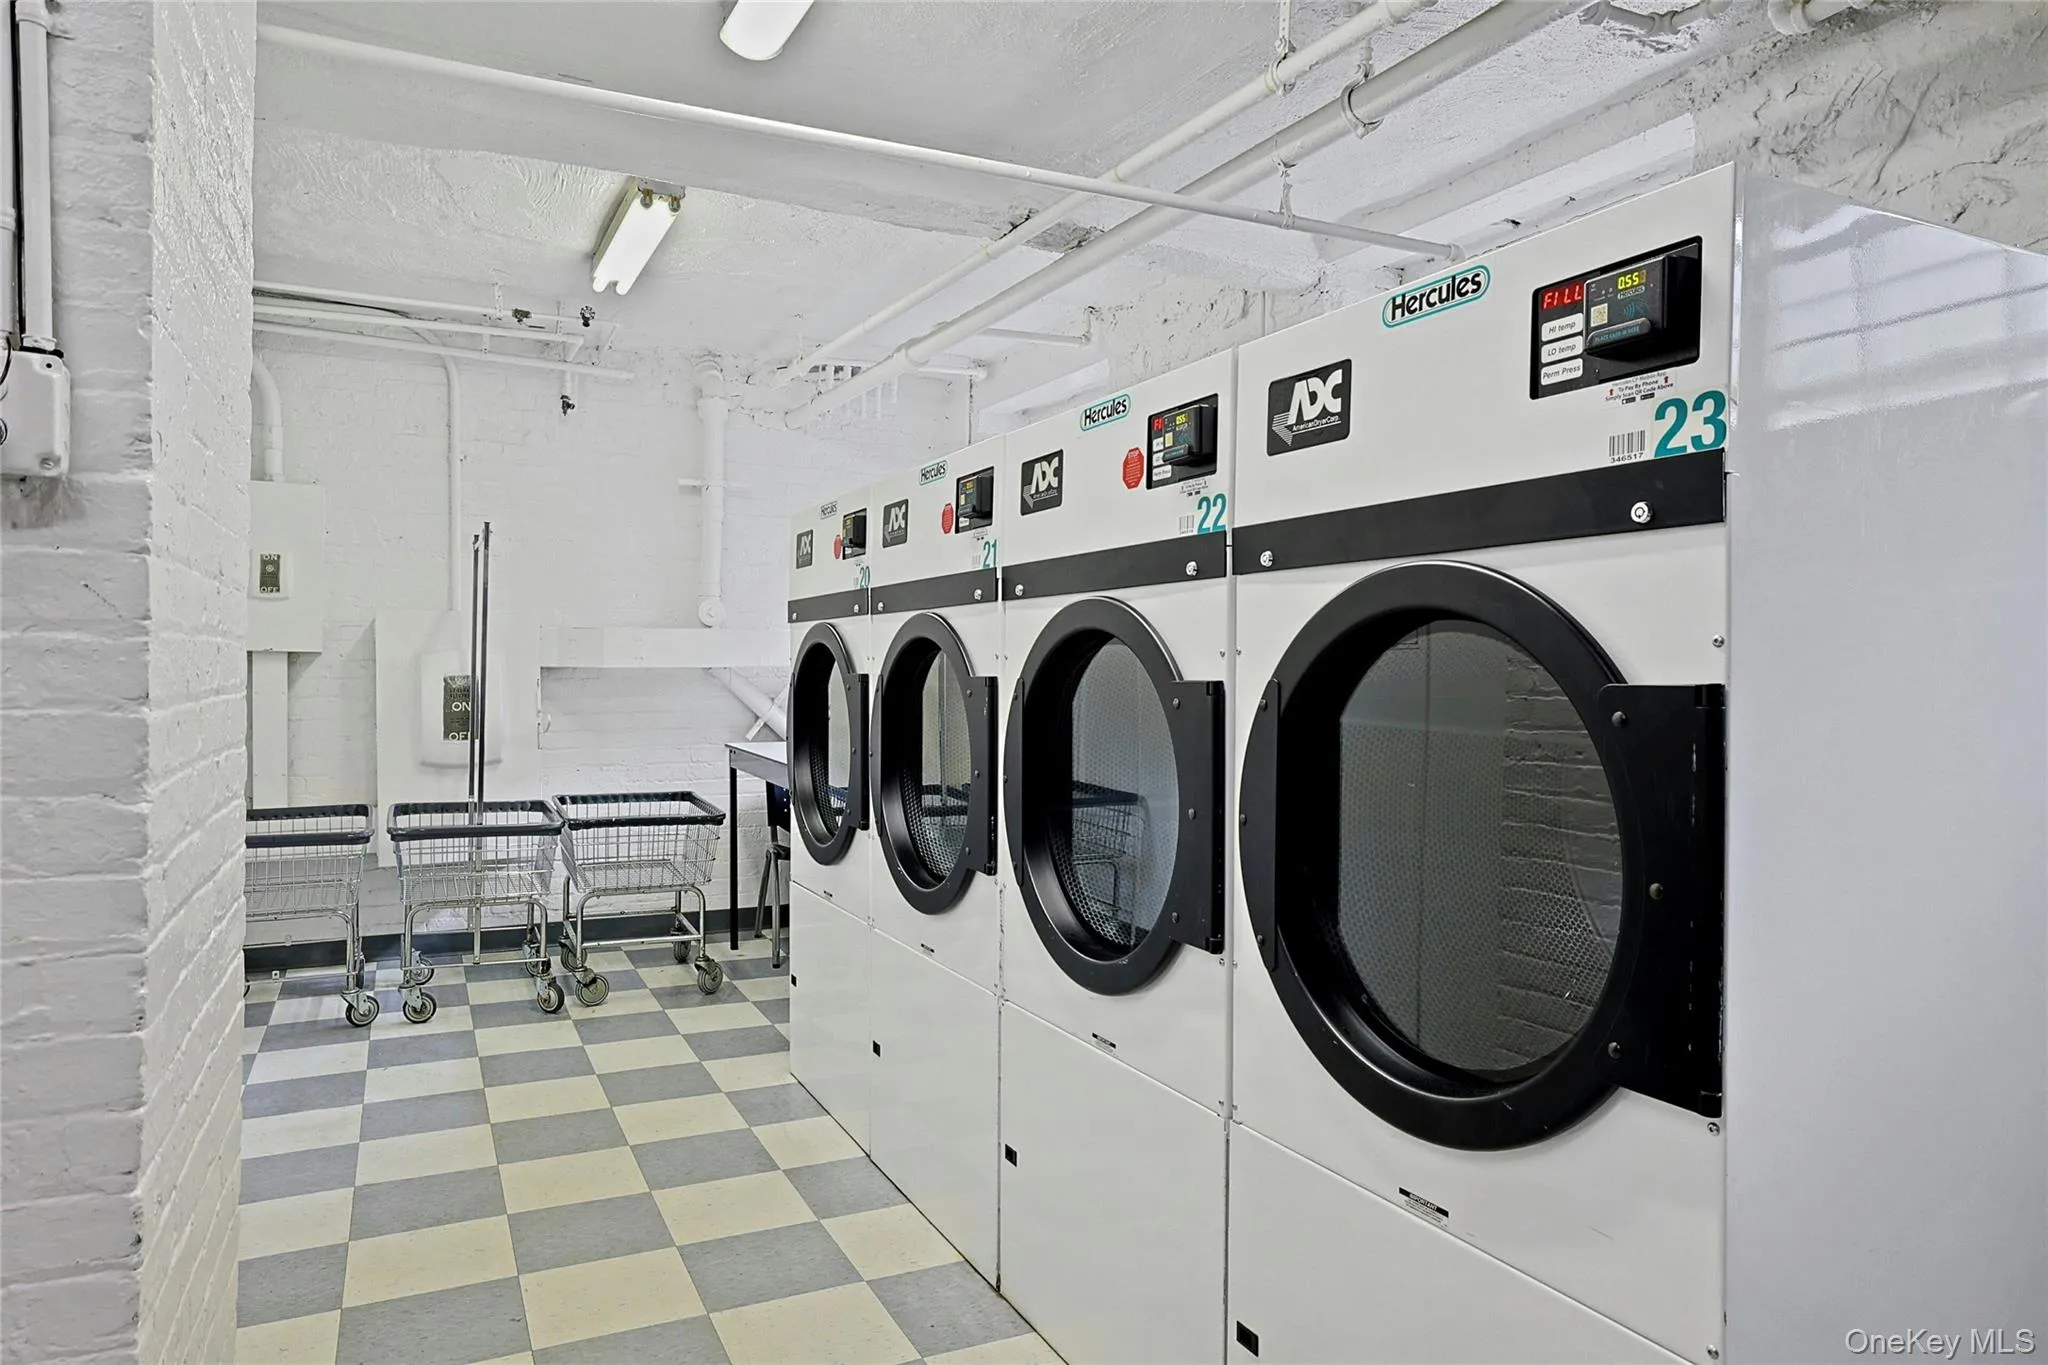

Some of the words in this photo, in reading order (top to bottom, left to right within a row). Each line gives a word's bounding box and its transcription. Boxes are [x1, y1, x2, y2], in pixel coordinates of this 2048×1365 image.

[1391, 272, 1483, 321] Hercules
[1543, 284, 1582, 309] FILL
[1549, 326, 1557, 334] HI
[1558, 321, 1576, 332] temp
[1548, 347, 1557, 356] LO
[1558, 343, 1576, 353] temp
[1543, 370, 1560, 380] Perm
[1562, 365, 1580, 376] Press
[1288, 368, 1342, 425] ADC
[1084, 397, 1127, 426] Hercules
[1654, 390, 1727, 458] 23
[920, 461, 946, 482] Hercules
[1610, 453, 1644, 463] 346517
[1031, 456, 1059, 494] ADC
[1197, 493, 1227, 534] 22
[983, 539, 997, 568] 21
[860, 566, 870, 588] 20
